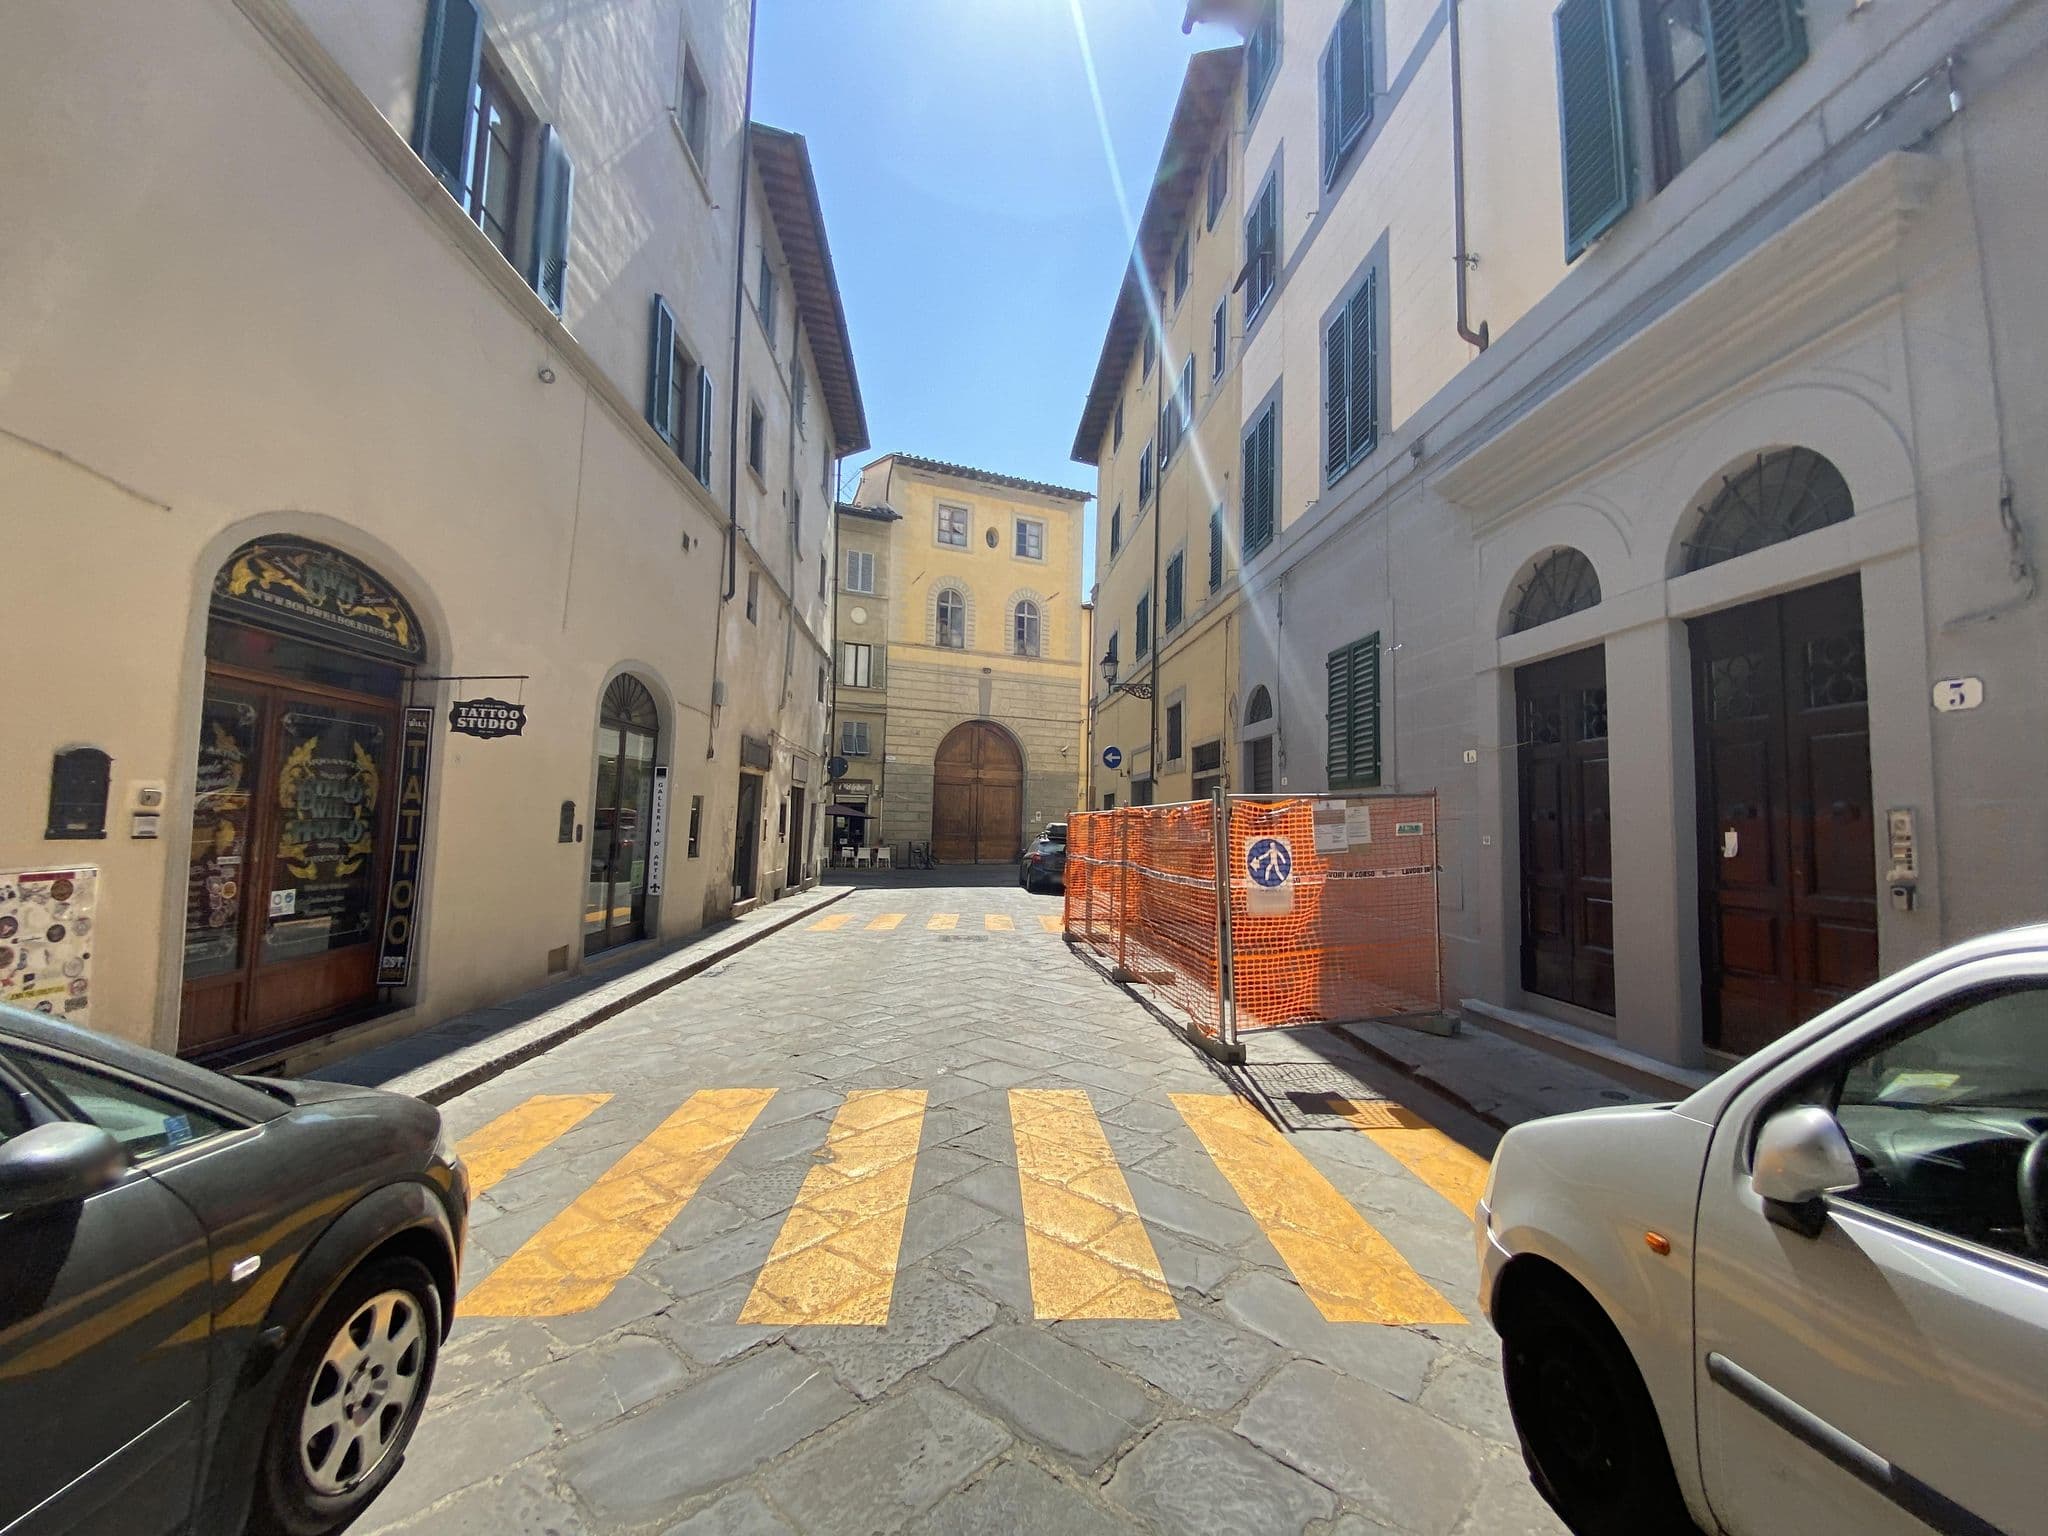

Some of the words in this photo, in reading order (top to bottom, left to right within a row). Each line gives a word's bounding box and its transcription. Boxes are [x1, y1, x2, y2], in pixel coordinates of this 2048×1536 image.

[1950, 682, 1964, 705] 5
[459, 707, 520, 719] TATTOO
[457, 717, 518, 730] STUDIO
[655, 782, 664, 833] GALLERIA
[387, 740, 426, 945] TATTOO
[1354, 870, 1376, 878] CORSO
